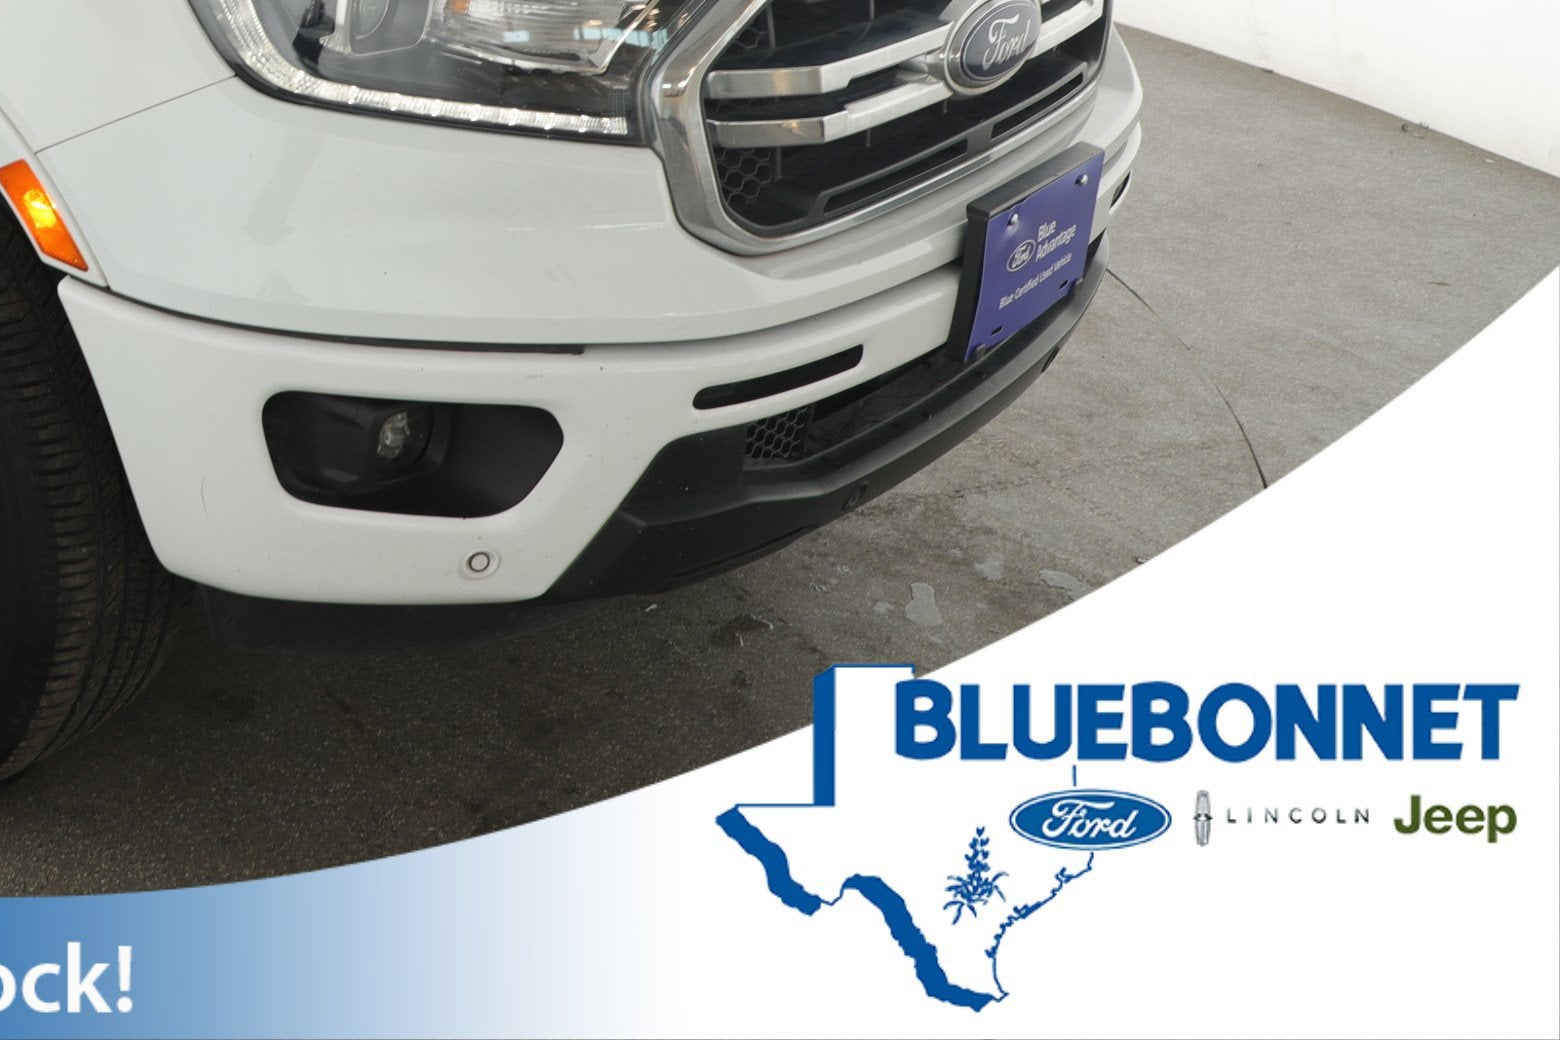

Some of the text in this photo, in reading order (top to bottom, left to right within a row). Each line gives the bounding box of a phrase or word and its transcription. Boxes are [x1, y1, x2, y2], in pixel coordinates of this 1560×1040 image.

[982, 13, 1031, 72] Ford
[1035, 224, 1077, 262] Advantage
[1037, 220, 1057, 242] Blue
[999, 293, 1015, 310] Blue
